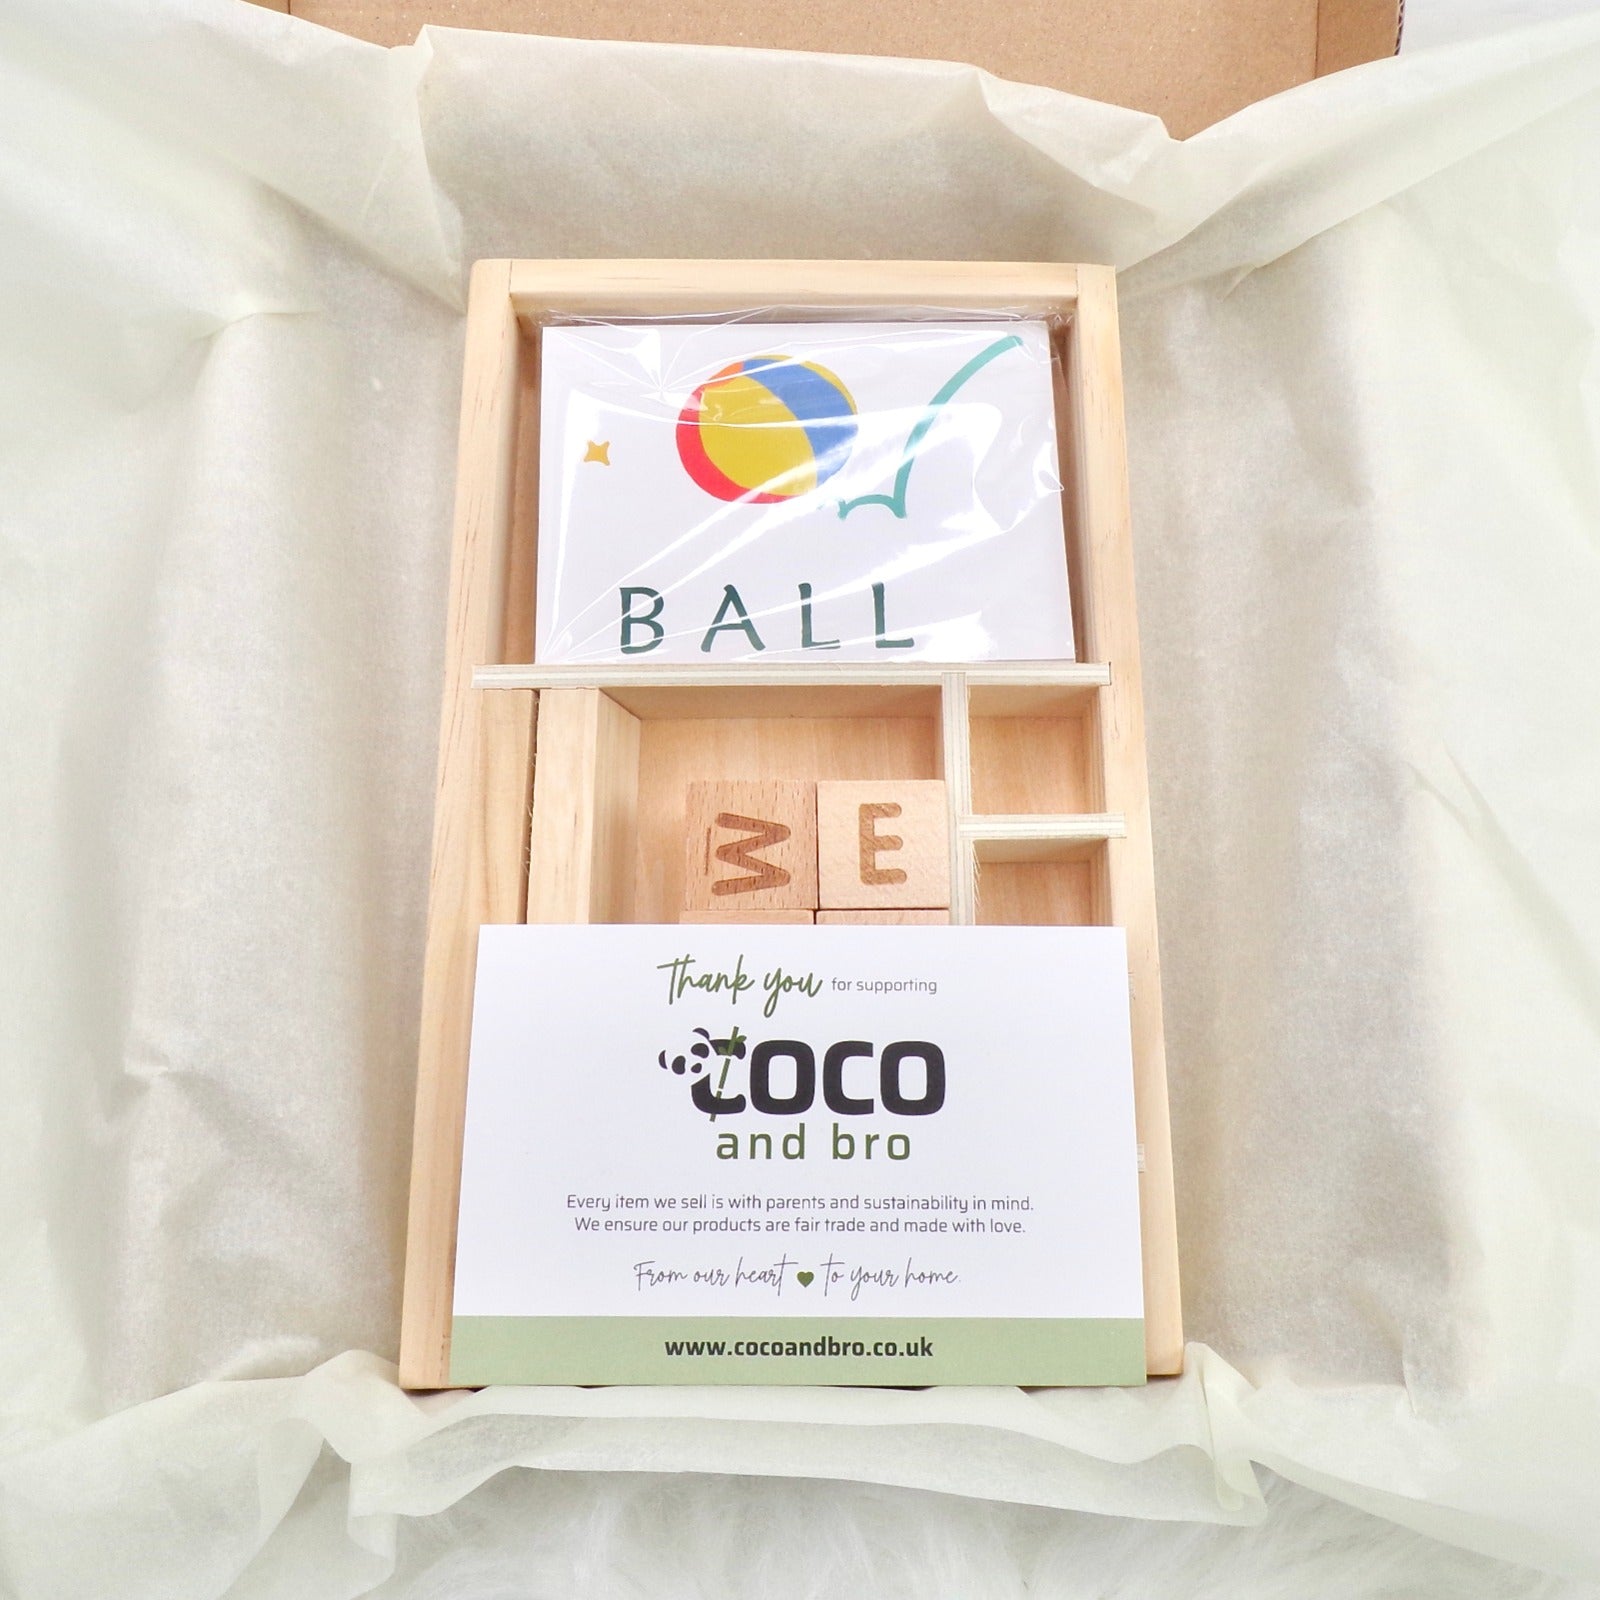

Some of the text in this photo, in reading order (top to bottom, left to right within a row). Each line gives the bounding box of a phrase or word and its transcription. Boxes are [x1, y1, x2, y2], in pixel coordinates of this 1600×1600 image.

[619, 582, 915, 655] BALL
[858, 802, 908, 886] E
[656, 953, 938, 1019] Thank you for supporting
[690, 1036, 947, 1117] COCO
[715, 1122, 911, 1162] and bro
[566, 1193, 1034, 1214] Every item we sell is with parents and sustainability in mind.
[574, 1216, 1026, 1236] We ensure our products are fair trade and made with love.
[633, 1252, 963, 1302] From our heart to your home.
[664, 1336, 934, 1358] www.cocoandbro.co.uk
